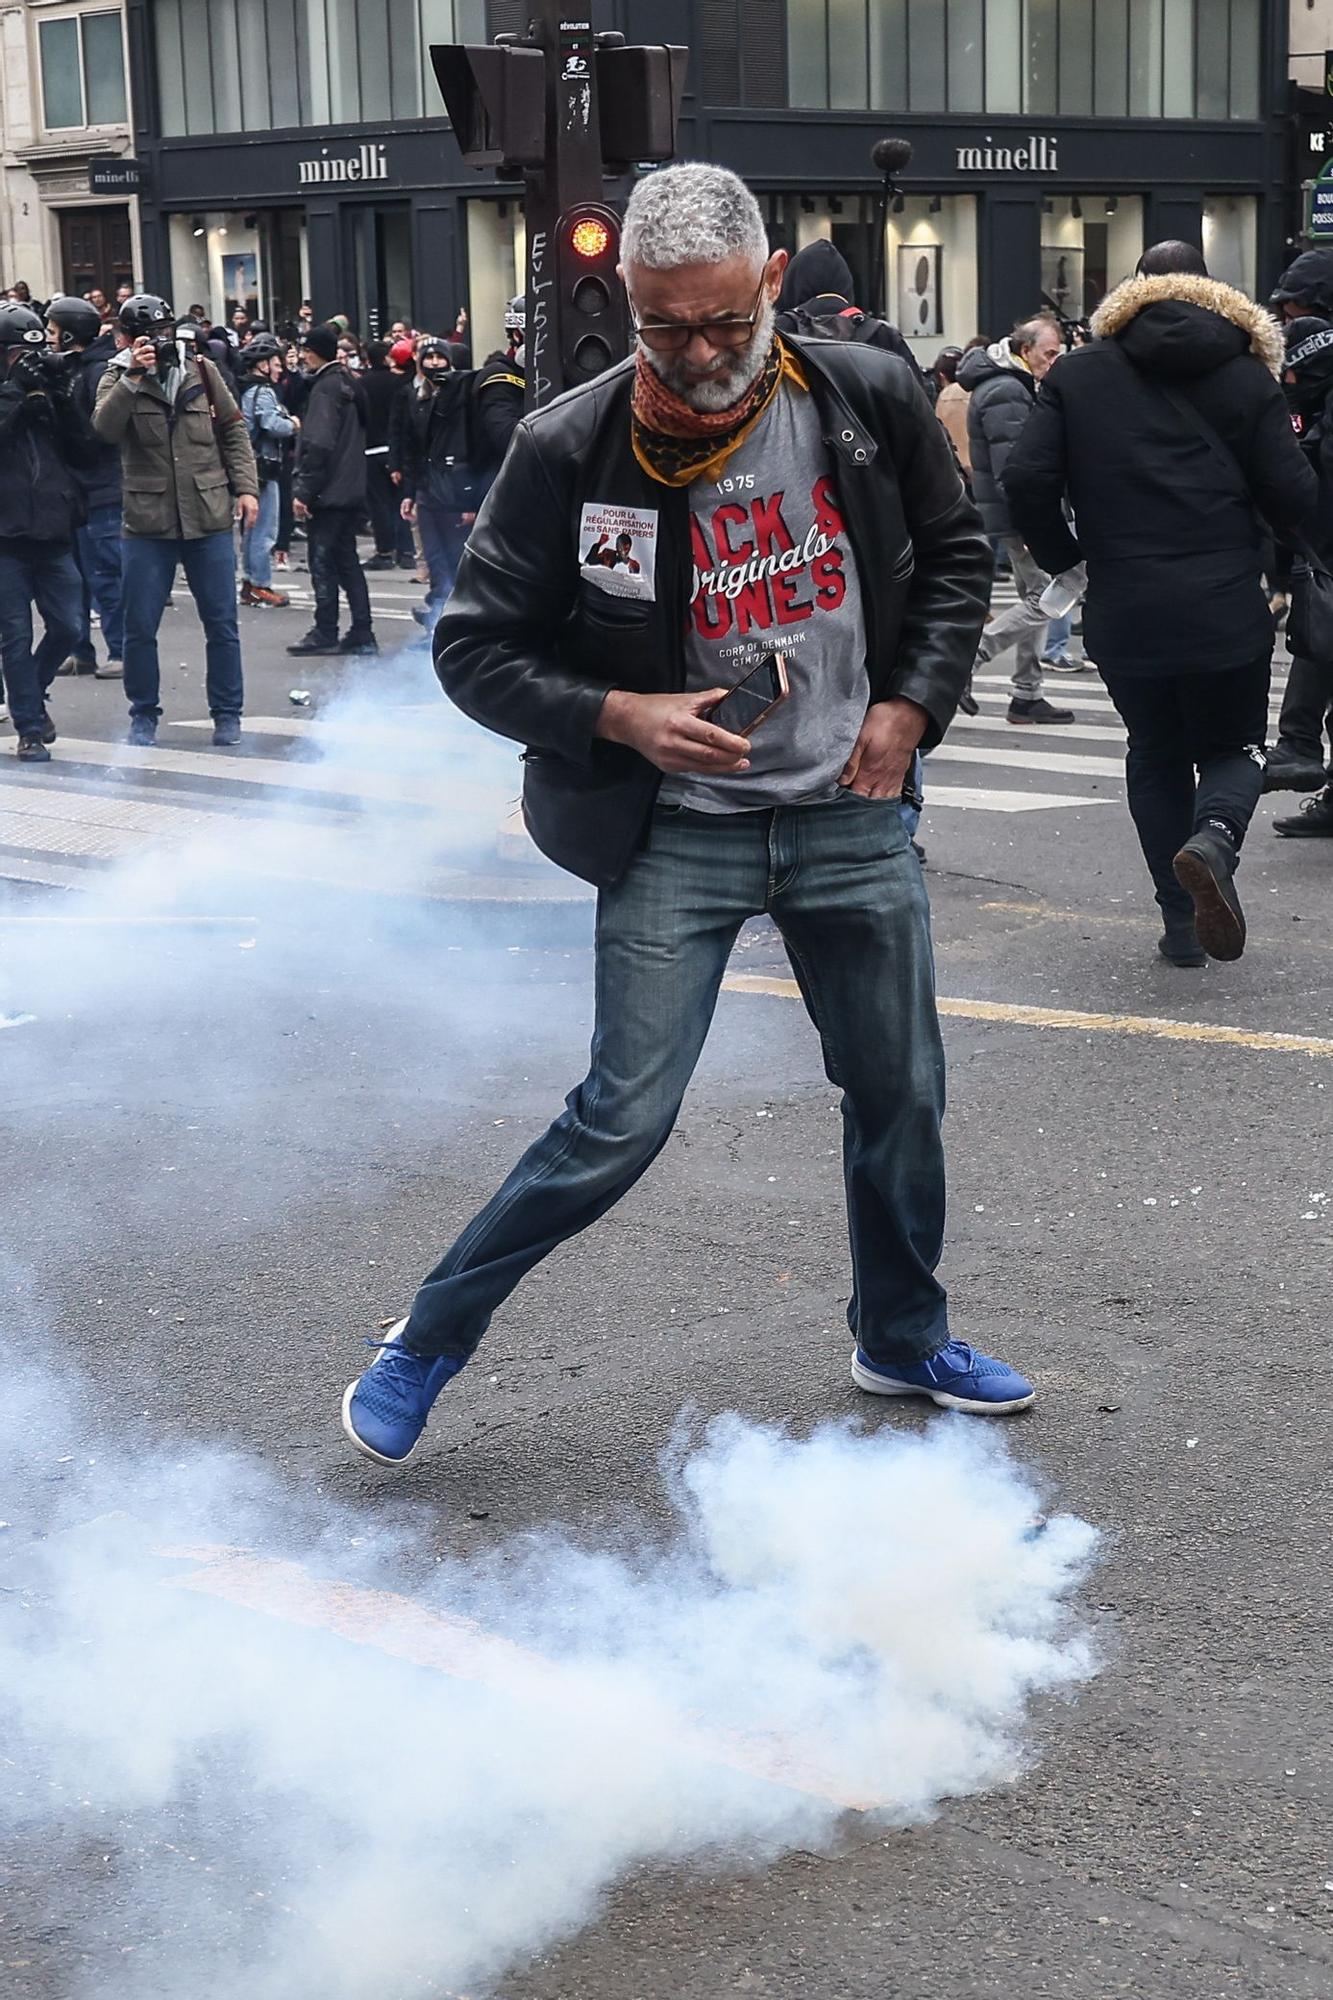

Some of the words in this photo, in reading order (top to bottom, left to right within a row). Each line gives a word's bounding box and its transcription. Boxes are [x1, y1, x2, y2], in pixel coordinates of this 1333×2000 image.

[299, 144, 388, 184] minelli
[955, 136, 1058, 171] minelli
[94, 169, 140, 186] minelli
[716, 474, 756, 496] 1975
[585, 514, 654, 531] RÉGULARISATION
[603, 509, 626, 519] POUR
[596, 526, 654, 538] SANS-PAPIERS
[690, 491, 795, 572] ACK
[685, 547, 847, 640] ONES
[719, 645, 745, 658] CORP
[747, 642, 758, 653] OF
[762, 632, 806, 650] DENMARK
[732, 656, 752, 668] CTM
